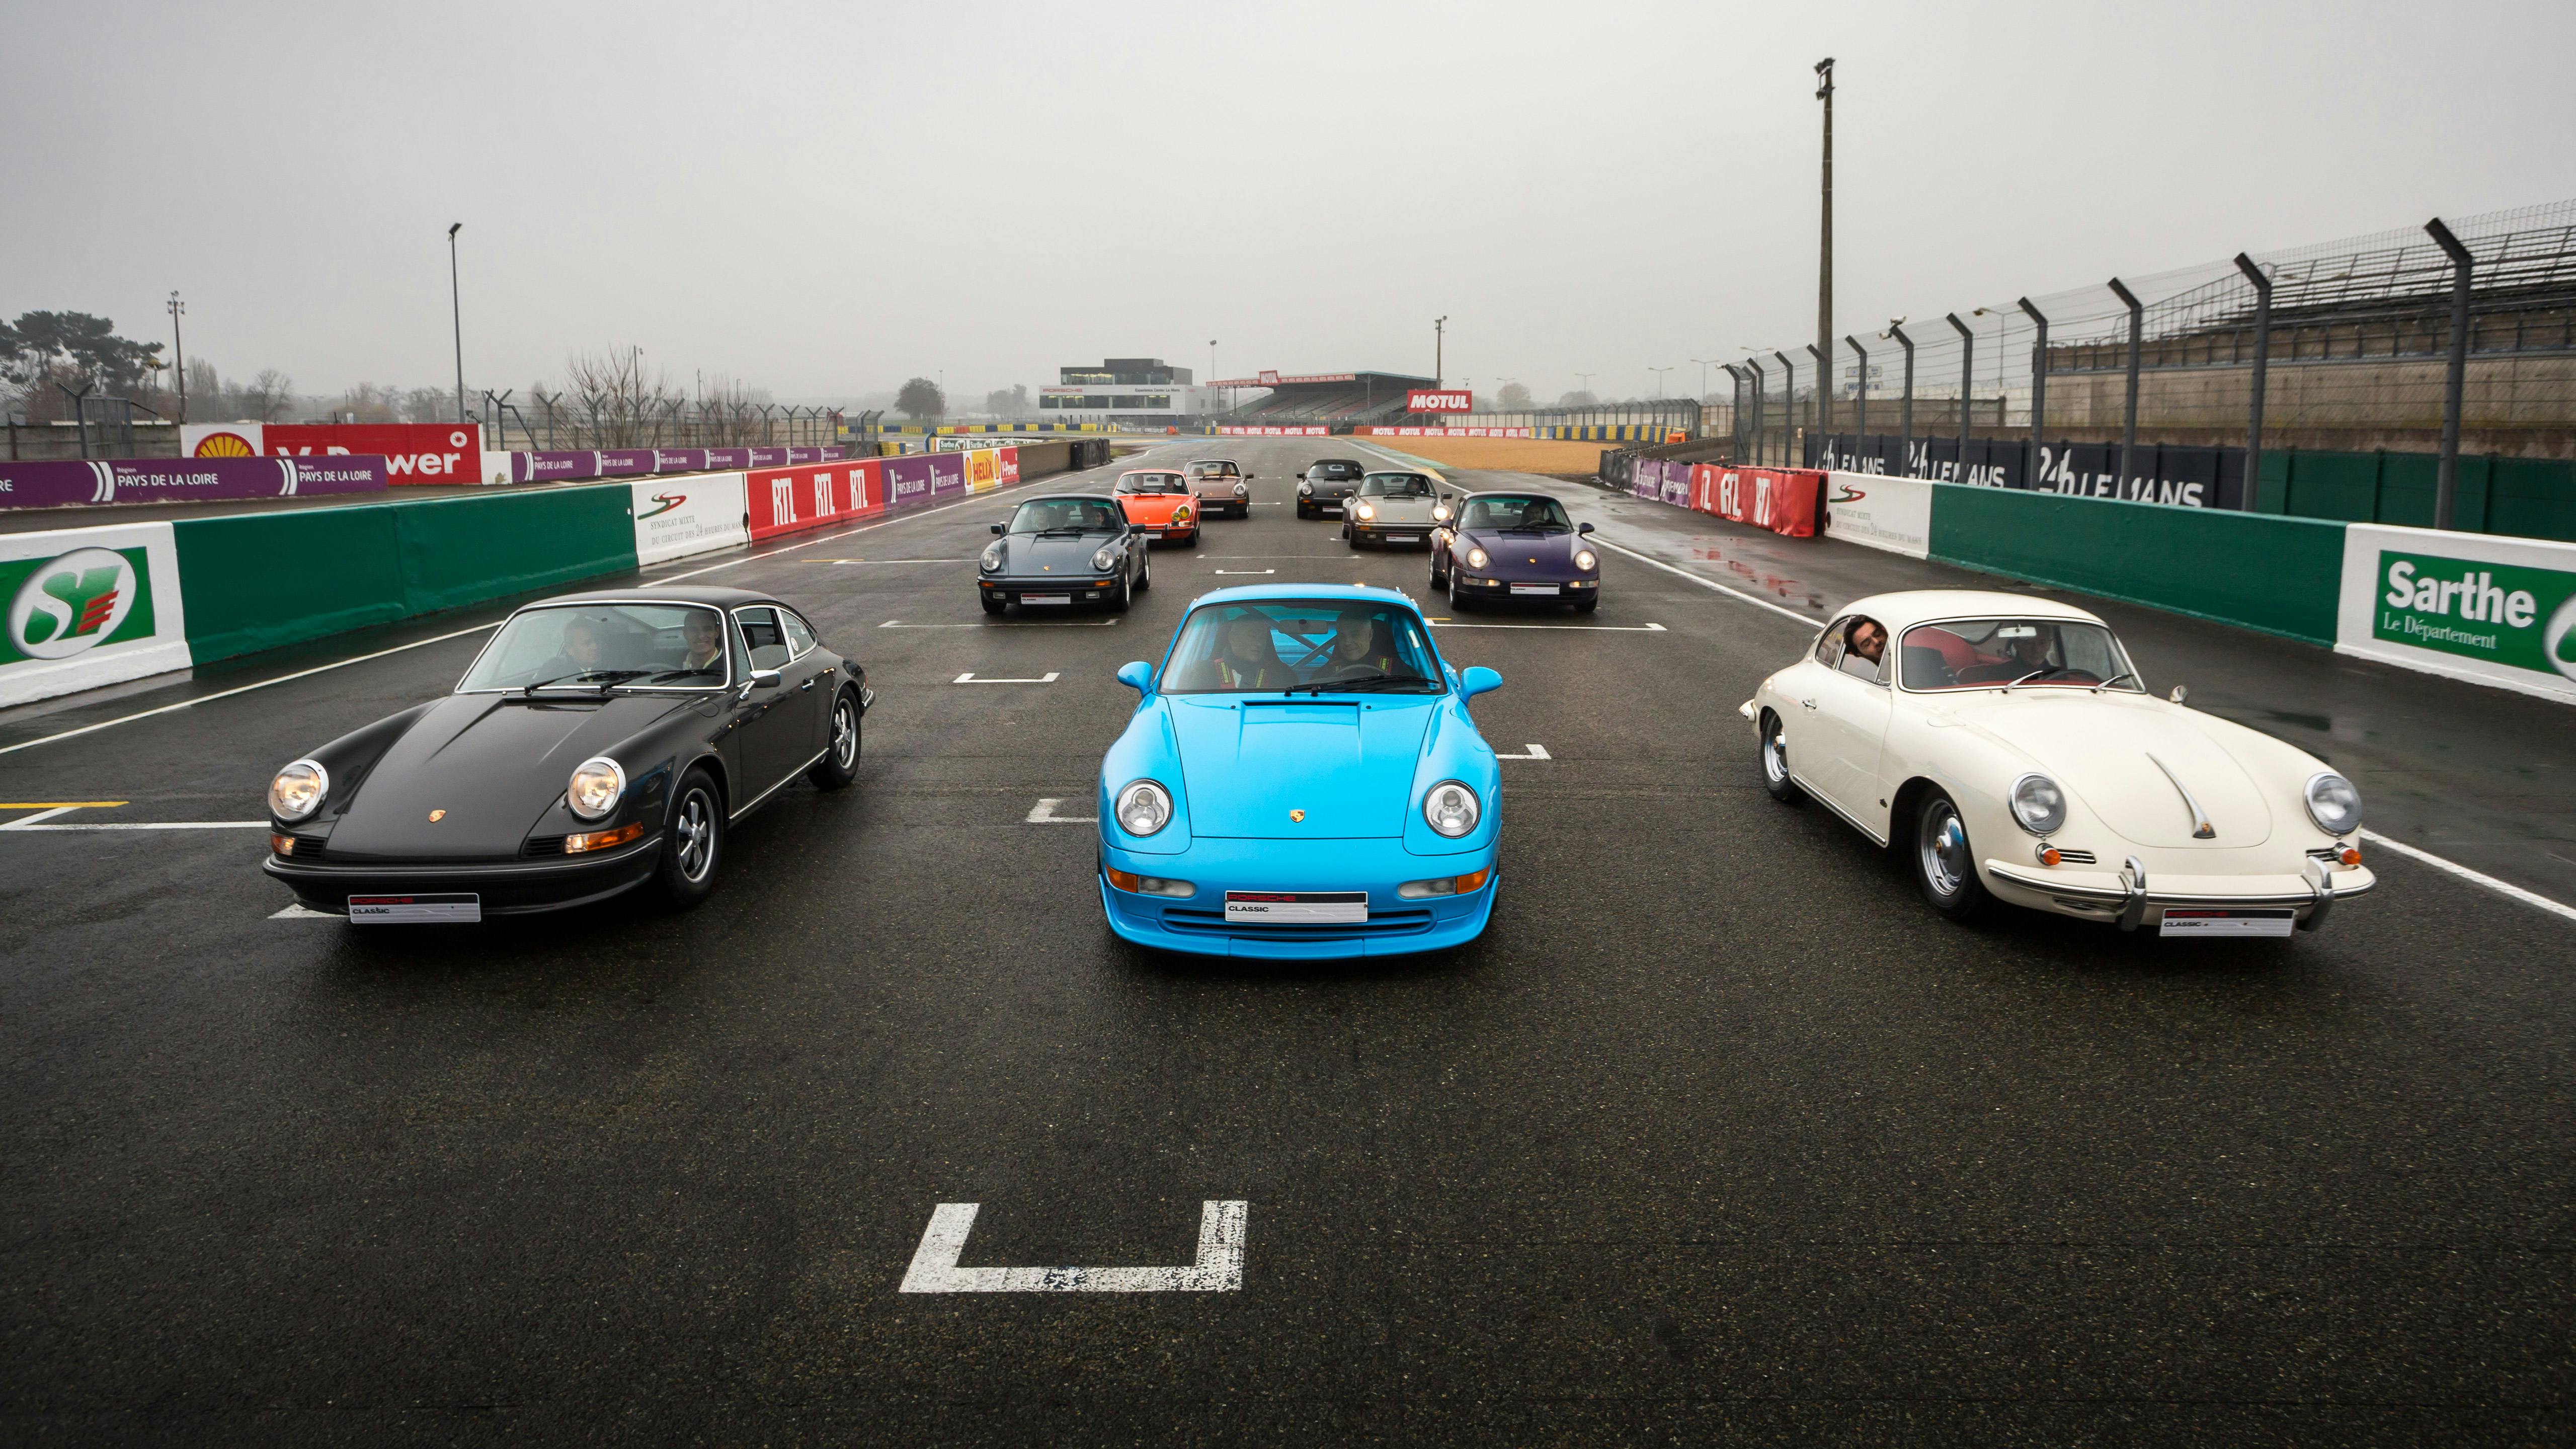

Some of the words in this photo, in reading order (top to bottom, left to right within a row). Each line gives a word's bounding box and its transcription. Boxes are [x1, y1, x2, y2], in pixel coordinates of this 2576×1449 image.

[1410, 394, 1469, 409] MOTUL
[1399, 428, 1420, 436] MOTUL
[1424, 428, 1444, 437] MOTUL
[1447, 428, 1466, 436] MOTUL
[1469, 428, 1486, 437] MOTUL
[1489, 429, 1503, 437] MOTUL
[534, 461, 546, 470] PAYS
[547, 461, 553, 470] DE
[553, 461, 560, 469] LA
[560, 460, 573, 469] LOIRE
[602, 459, 612, 467] PAYS
[1001, 460, 1017, 477] V-Power
[299, 471, 321, 482] PAYS
[325, 471, 336, 481] DE
[338, 470, 349, 481] LA
[351, 470, 372, 480] LOIRE
[973, 460, 993, 481] HELIX
[118, 474, 148, 487] PAYS
[151, 474, 167, 486] DE
[170, 473, 184, 486] LA
[187, 473, 218, 486] LOIRE
[897, 481, 906, 495] PAYS
[906, 481, 911, 494] DE
[911, 480, 916, 493] LA
[917, 479, 925, 492] LOIRE
[943, 476, 947, 487] DE
[947, 475, 951, 486] LA
[814, 473, 835, 518] RTL
[849, 469, 868, 511] RTL
[771, 477, 797, 526] RTL
[651, 518, 678, 530] SYNDICAT
[679, 515, 695, 525] MIXTE
[1871, 522, 1877, 536] 24
[652, 537, 660, 545] DU
[662, 532, 683, 544] CIRCUIT
[685, 530, 694, 539] DES
[696, 524, 703, 536] 24
[704, 525, 722, 535] HEURES
[732, 520, 744, 530] MANS
[2385, 560, 2536, 628] Sarthe
[2383, 612, 2400, 631] Le
[2404, 615, 2497, 650] Département
